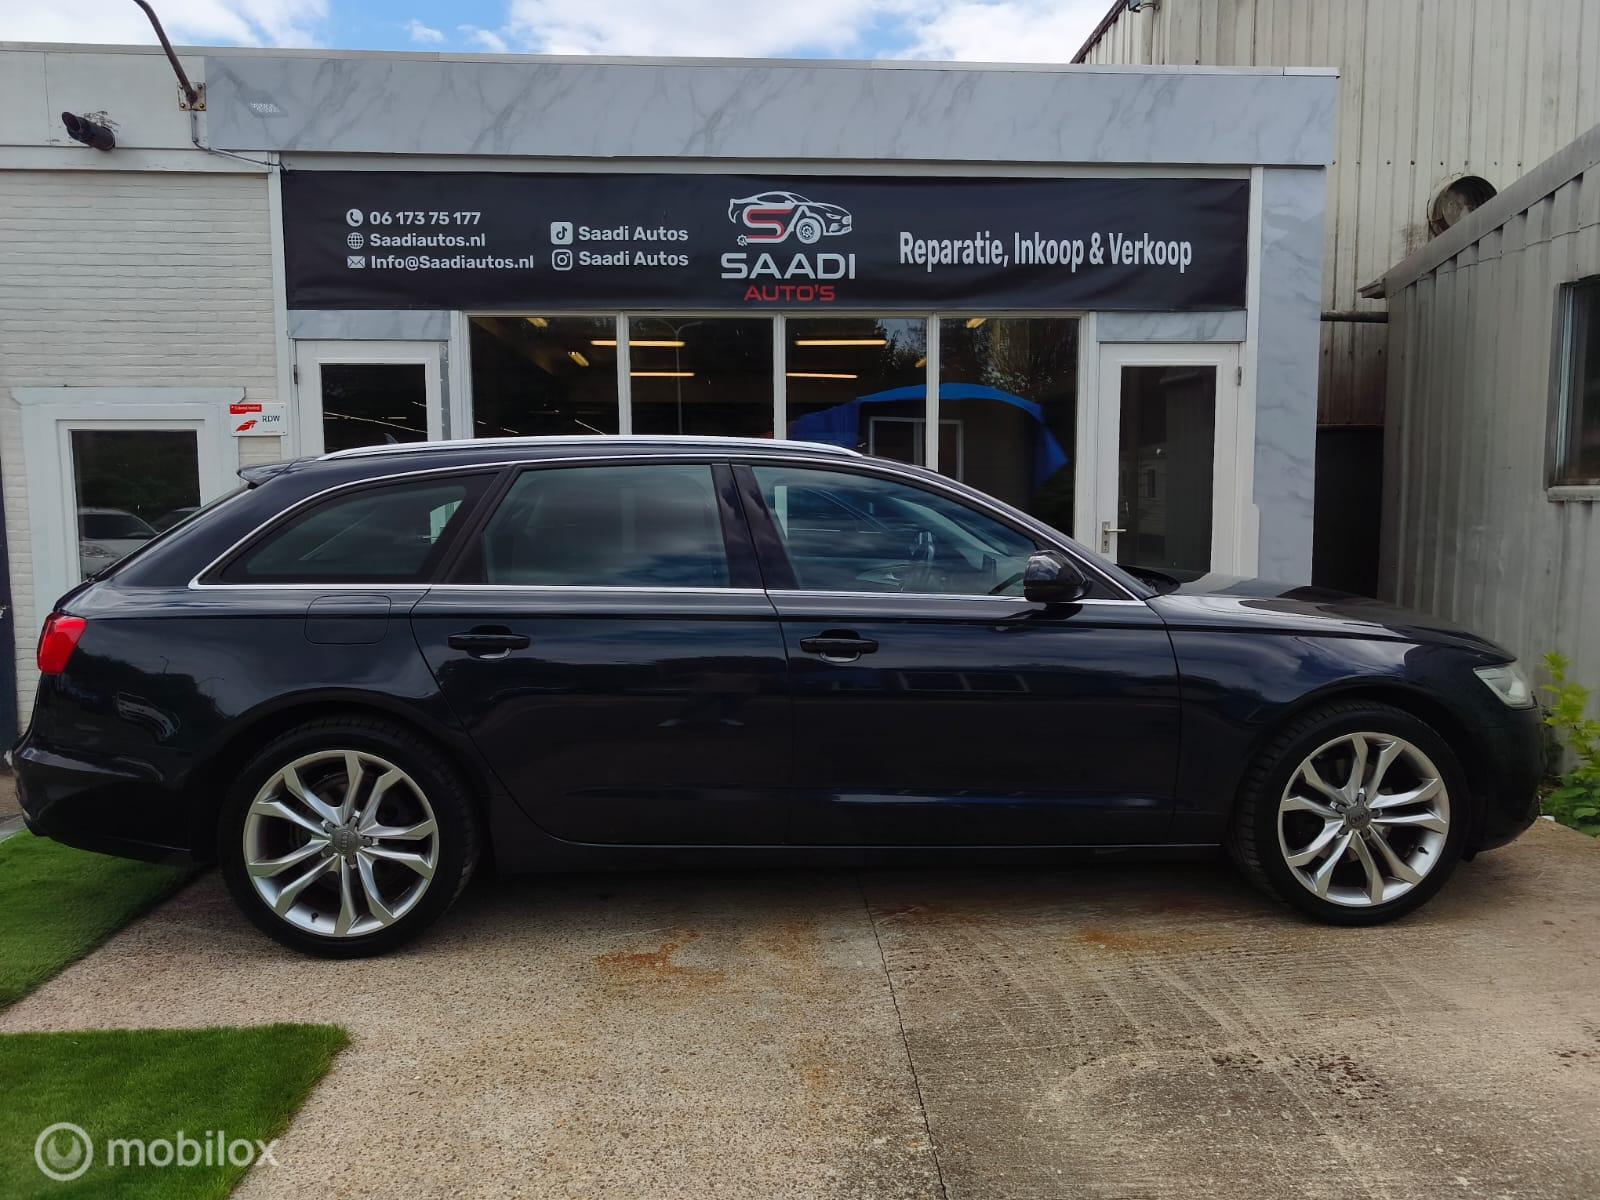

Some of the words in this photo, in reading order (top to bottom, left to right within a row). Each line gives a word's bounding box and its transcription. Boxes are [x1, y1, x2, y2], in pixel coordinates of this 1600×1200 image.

[369, 211, 391, 224] 06
[396, 211, 424, 224] 173
[429, 211, 449, 224] 75
[453, 211, 481, 224] 177
[369, 233, 486, 247] Saadiautos.nl
[578, 226, 629, 241] Saadi
[633, 226, 689, 241] Autos
[578, 251, 630, 266] Saadi
[634, 251, 689, 266] Autos
[899, 230, 1009, 272] Reparatie,
[1014, 231, 1084, 273] Inkoop
[1089, 232, 1104, 265] &
[1108, 232, 1192, 274] Verkoop
[370, 255, 534, 270] Info@Saadiautos.nl
[721, 253, 856, 280] SAADI
[744, 285, 836, 301] AUTO'S
